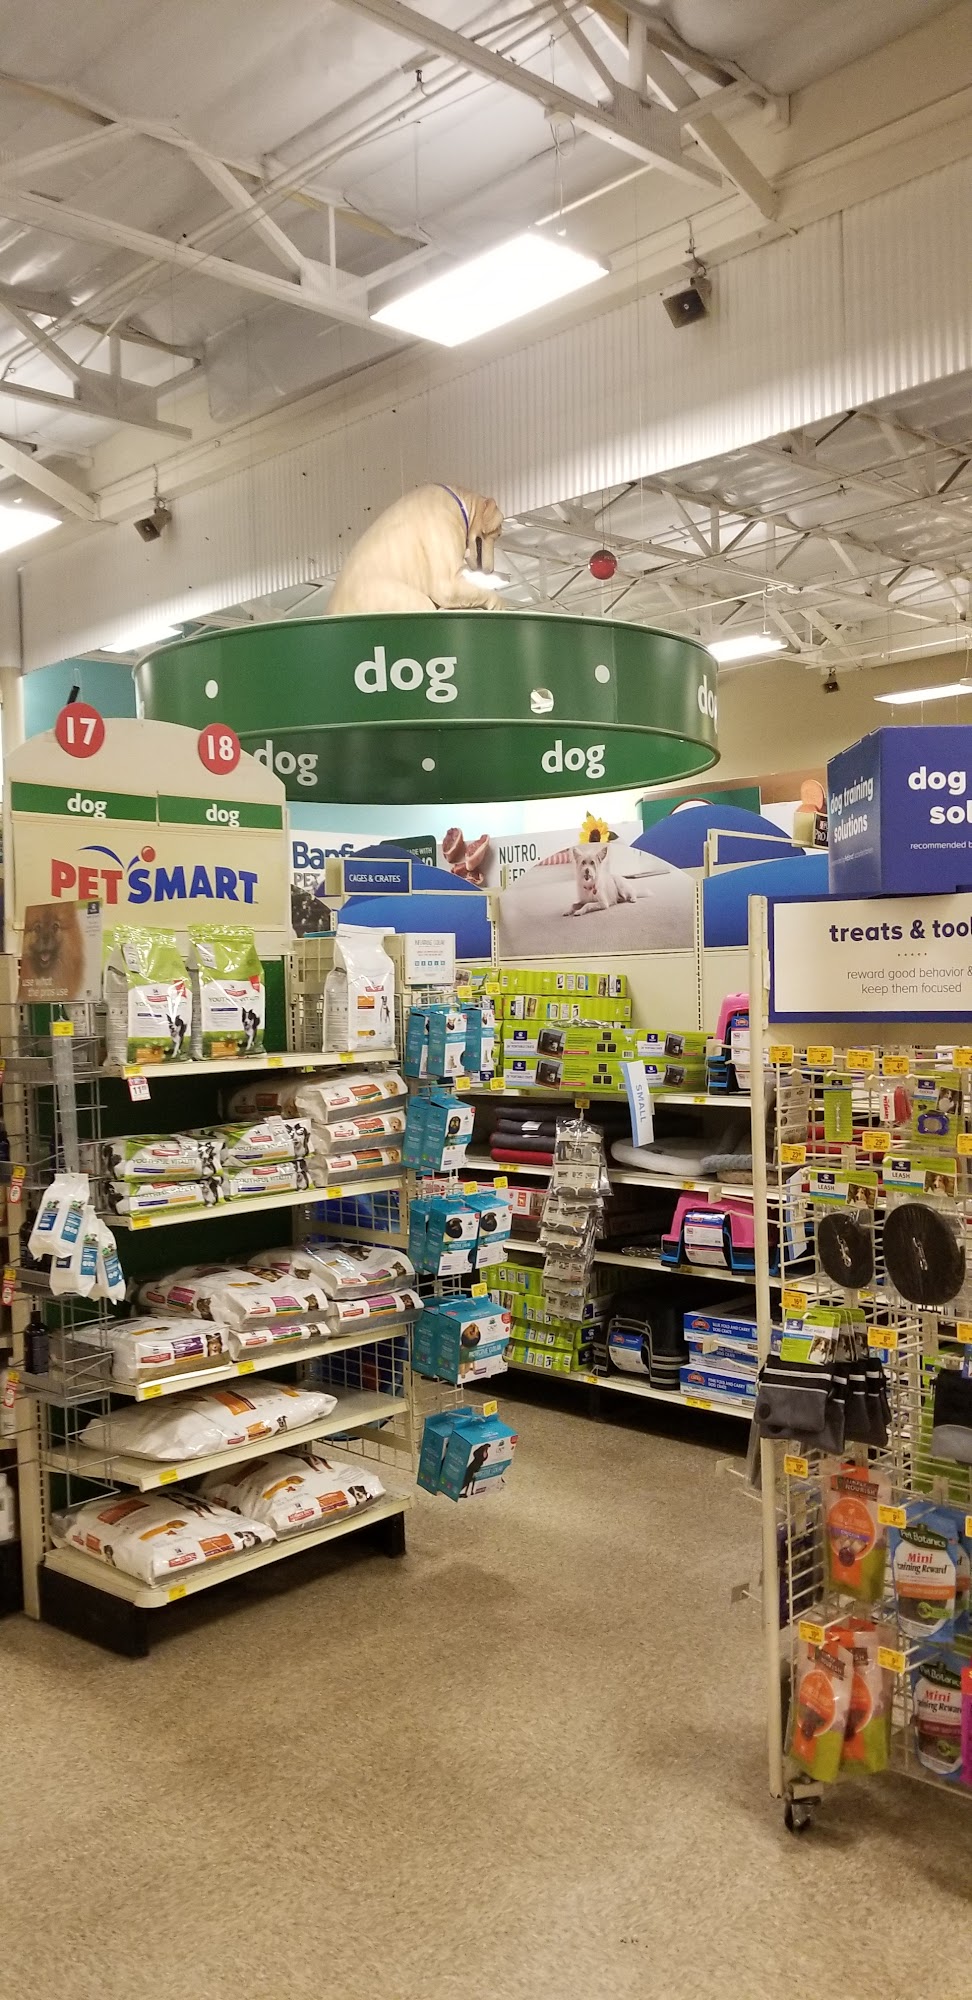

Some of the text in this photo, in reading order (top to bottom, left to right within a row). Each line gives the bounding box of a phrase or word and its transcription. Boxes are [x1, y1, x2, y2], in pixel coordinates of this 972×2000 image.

[354, 645, 457, 703] dog
[66, 716, 97, 745] 17
[207, 735, 235, 761] 18
[541, 739, 606, 779] dog
[253, 739, 319, 786] dog
[908, 766, 967, 795] dog
[67, 793, 107, 819] dog
[830, 775, 874, 815] dog training
[206, 803, 240, 828] dog
[834, 814, 868, 843] solutions
[499, 843, 541, 865] NUTRO.
[910, 841, 966, 850] recommended
[51, 858, 258, 905] PETSMART
[294, 872, 320, 888] PET
[349, 874, 401, 883] CAGES & CRATES
[829, 922, 903, 943] treats
[909, 919, 926, 940] &
[847, 968, 885, 980] reward
[888, 968, 916, 981] good
[919, 966, 964, 979] behavior
[861, 982, 962, 996] keep them focused
[635, 1084, 647, 1123] SMALL
[892, 1171, 911, 1180] LEASH
[817, 1184, 835, 1192] LEASH
[907, 1553, 933, 1564] Mini
[922, 1564, 948, 1574] Reward
[925, 1690, 951, 1703] Mini
